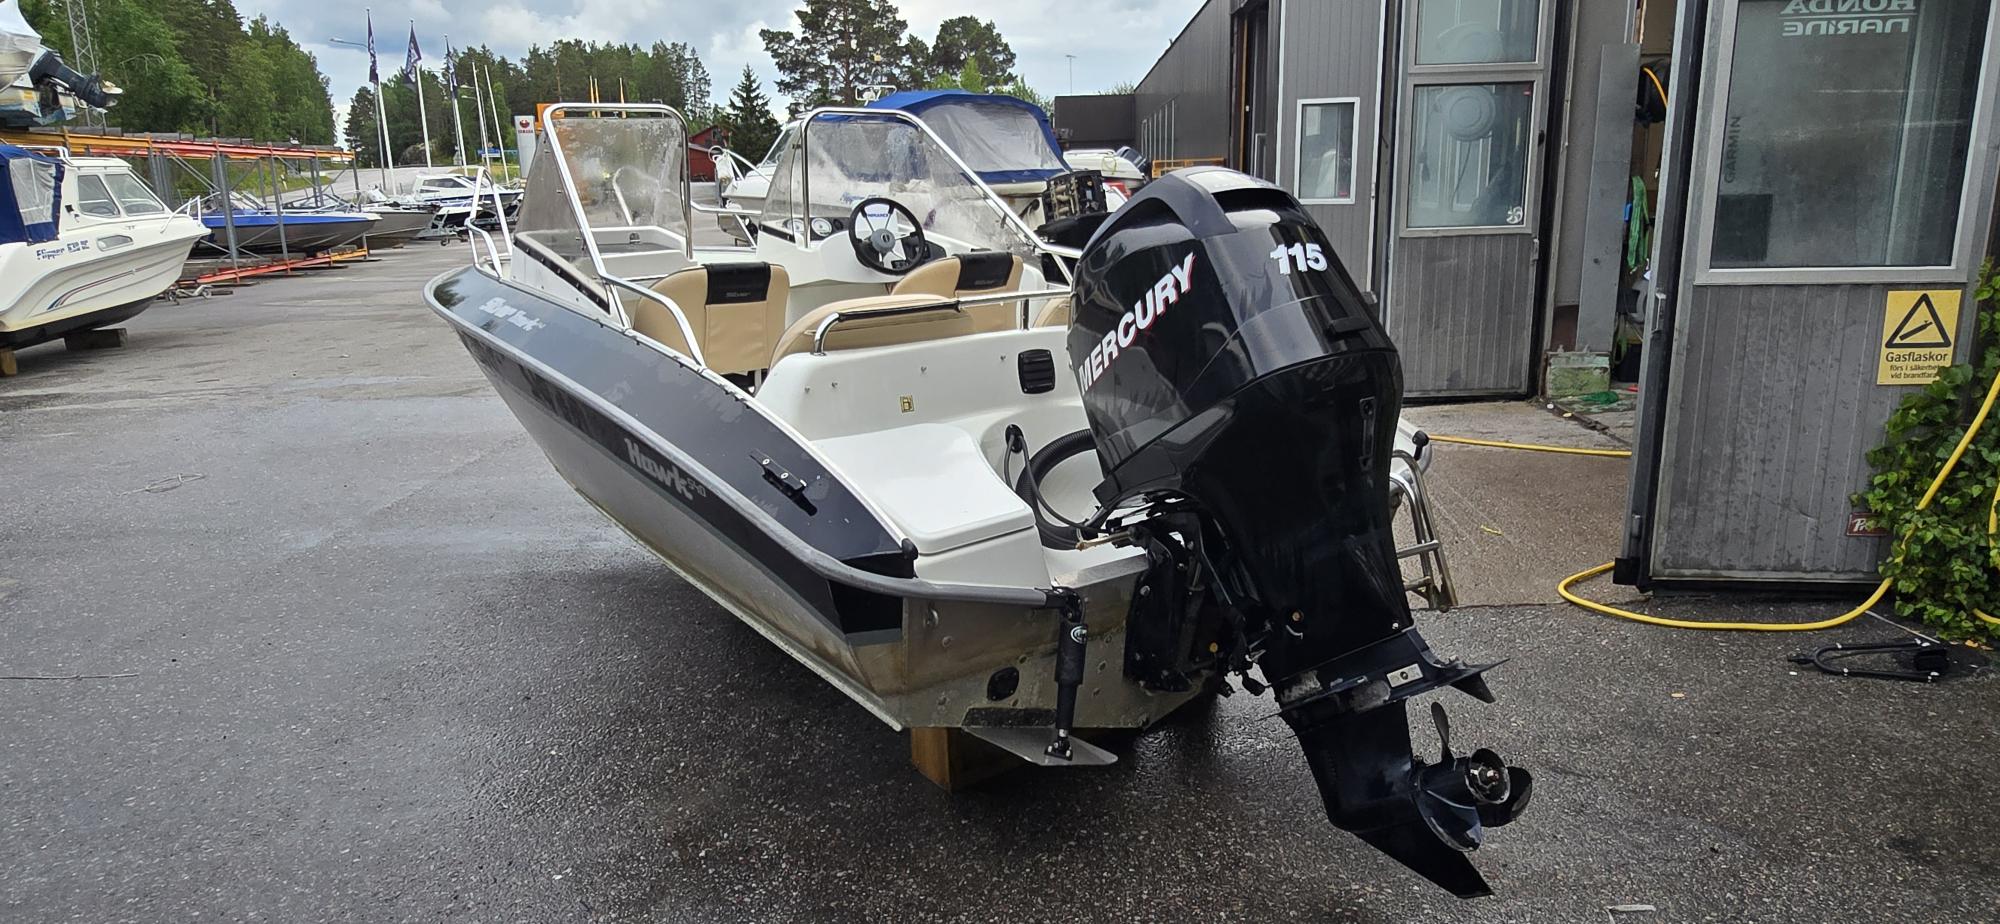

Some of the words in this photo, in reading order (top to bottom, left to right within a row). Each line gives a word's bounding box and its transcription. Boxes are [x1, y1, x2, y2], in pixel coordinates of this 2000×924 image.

[1724, 116, 1741, 183] GARMIN
[1270, 242, 1328, 275] 115
[1078, 252, 1196, 397] MERCURY
[1885, 351, 1949, 362] Gasflaskor
[624, 438, 694, 500] Hawk
